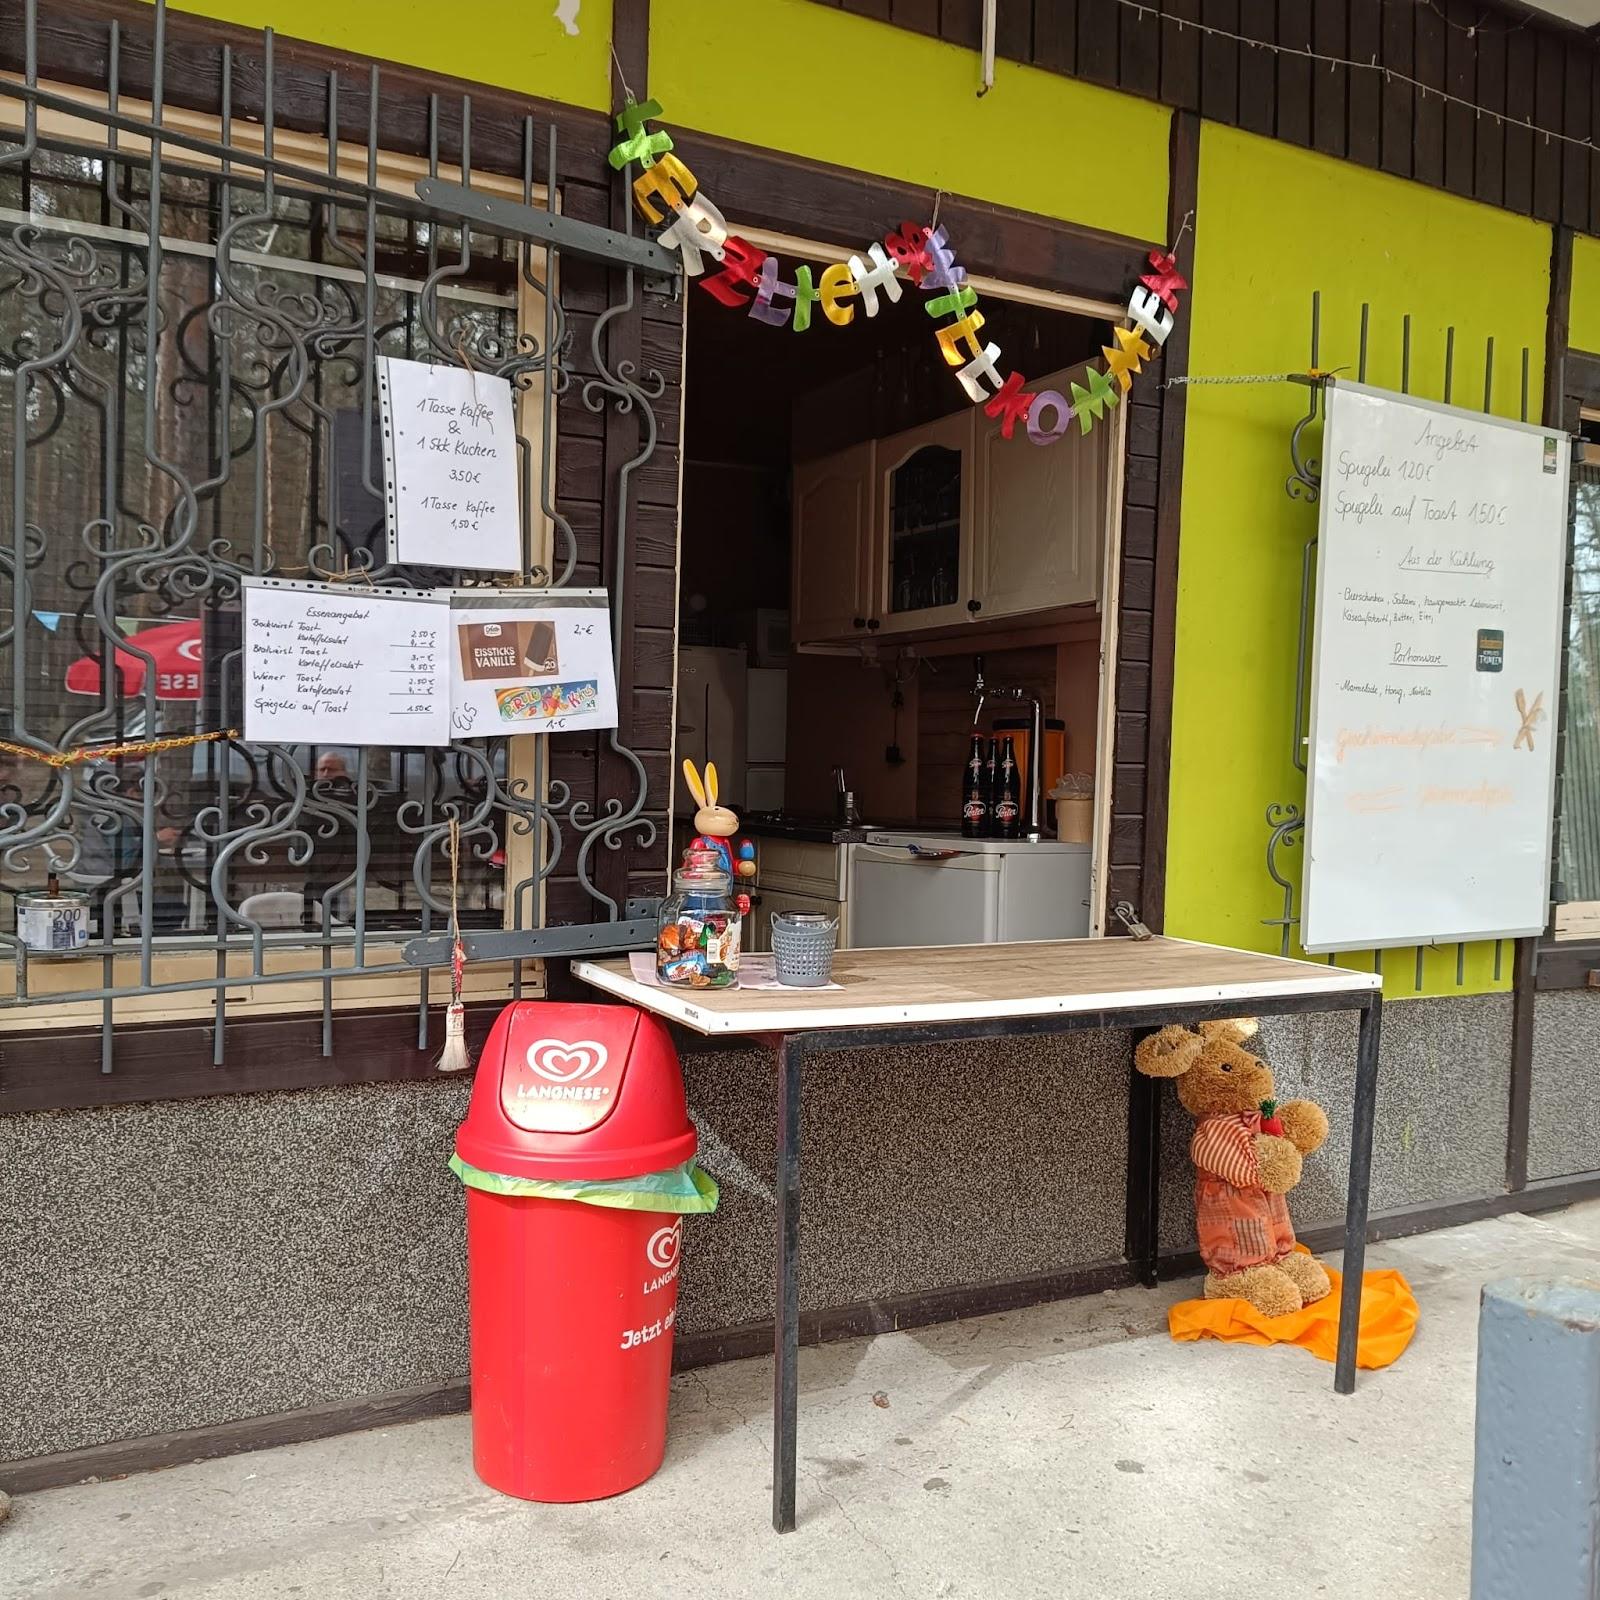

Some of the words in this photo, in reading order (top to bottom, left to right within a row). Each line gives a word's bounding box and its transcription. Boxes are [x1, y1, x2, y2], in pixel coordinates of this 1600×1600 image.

[428, 398, 456, 416] Tasse
[448, 420, 461, 435] &
[417, 436, 425, 449] 1
[454, 439, 497, 458] Kuchen
[430, 496, 458, 510] Tasse
[1392, 495, 1417, 525] auf
[1421, 498, 1458, 521] Toast
[297, 622, 321, 631] Toast
[300, 646, 328, 655] Toast
[473, 646, 516, 657] EISSTICKS
[475, 656, 517, 668] VANILLE
[253, 671, 286, 681] Wiener
[296, 673, 322, 682] Toast
[302, 700, 320, 715] auf
[321, 701, 349, 713] Toast
[53, 908, 81, 922] 200
[516, 1084, 602, 1101] LANGNESE
[620, 1319, 662, 1350] Jetzt
